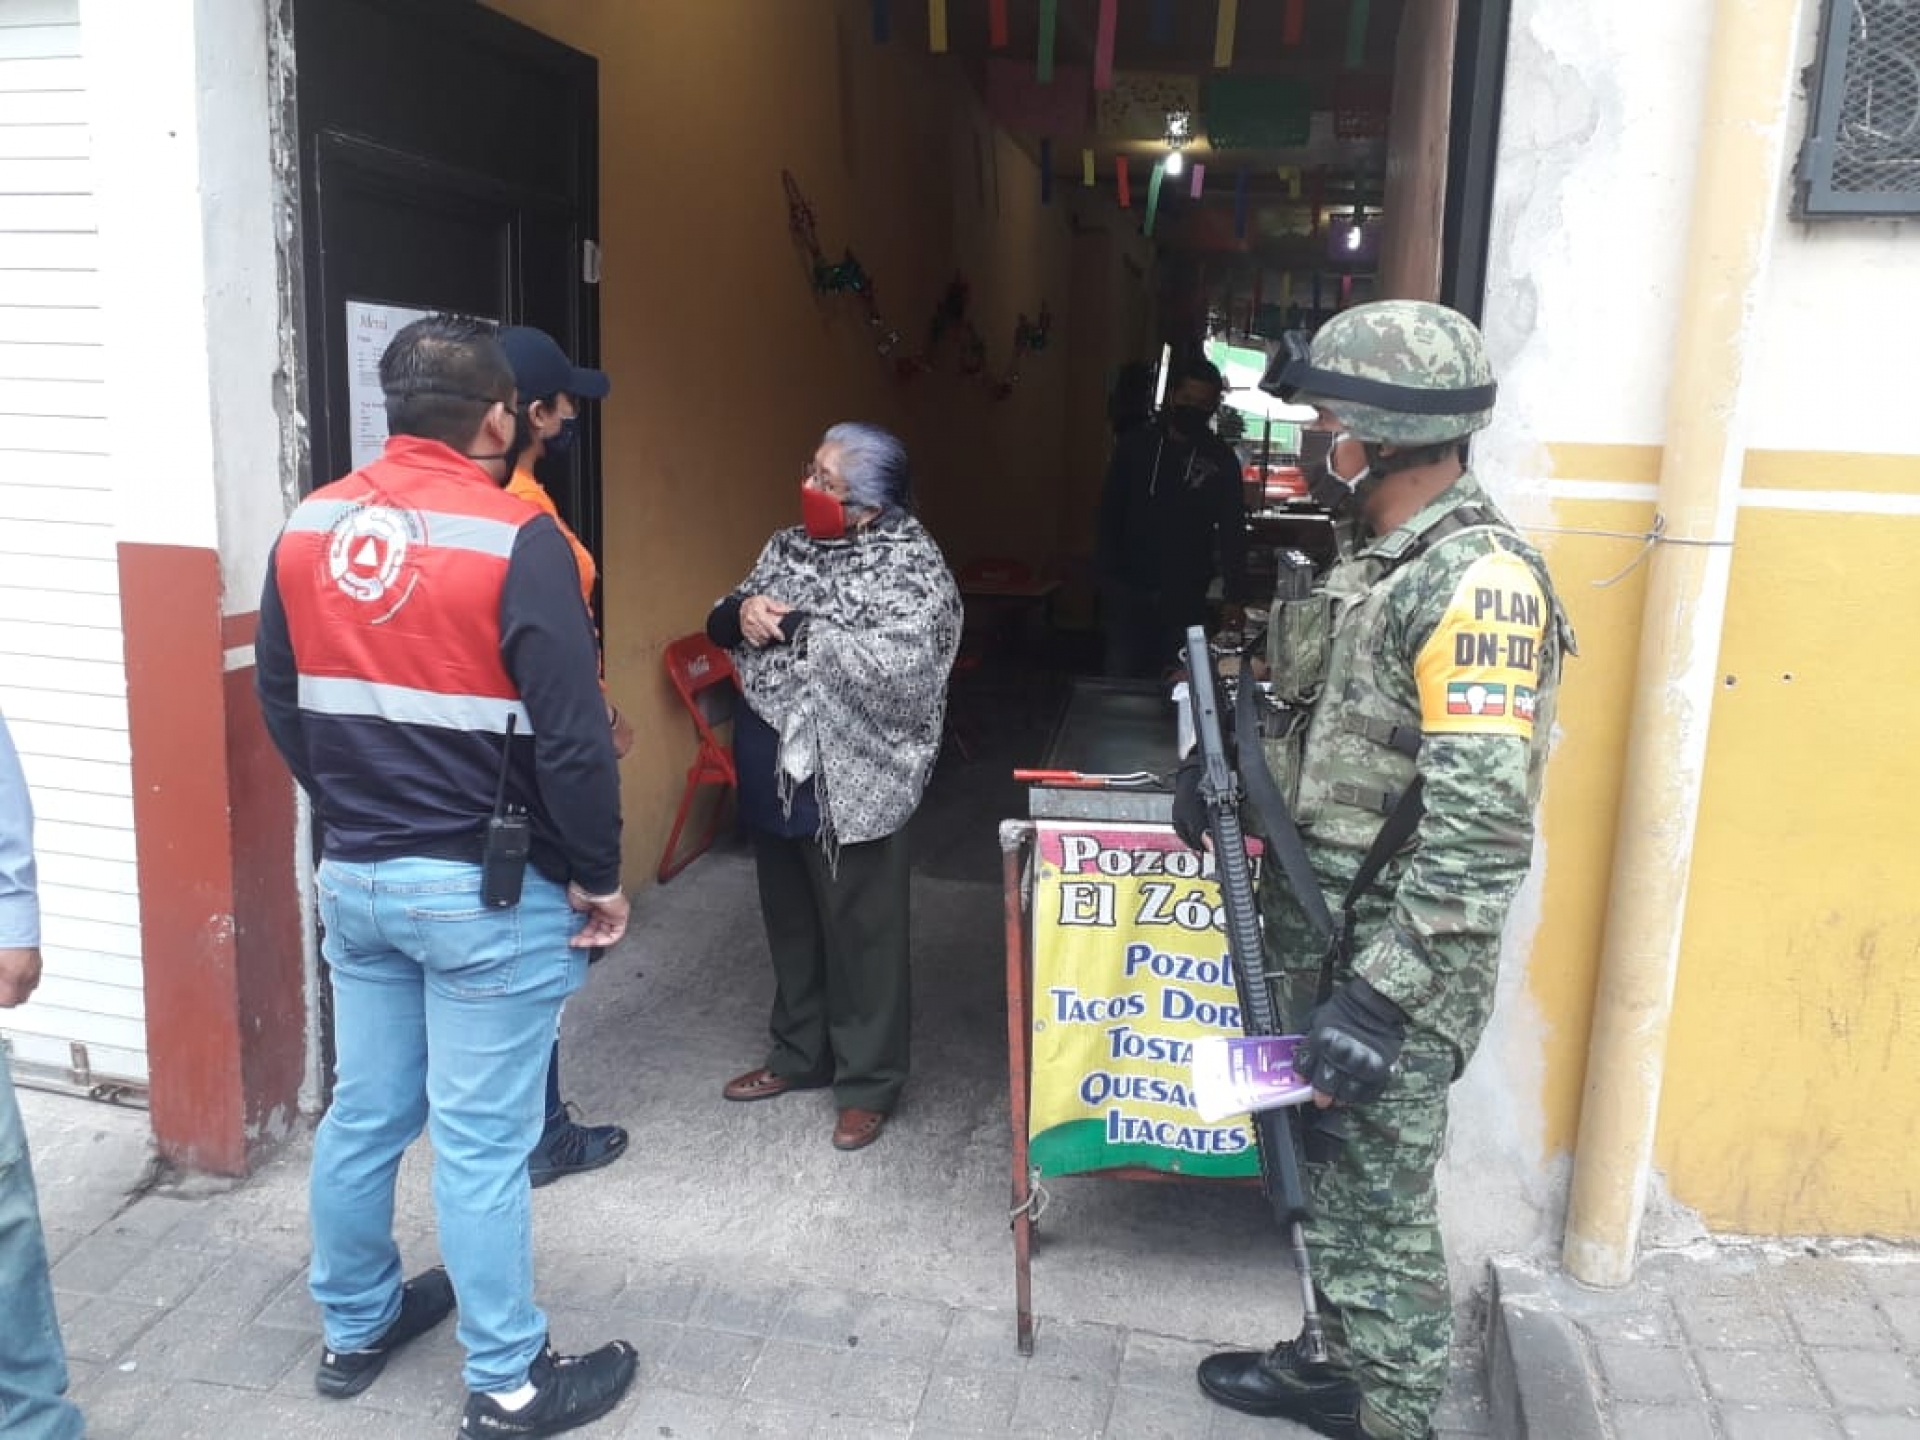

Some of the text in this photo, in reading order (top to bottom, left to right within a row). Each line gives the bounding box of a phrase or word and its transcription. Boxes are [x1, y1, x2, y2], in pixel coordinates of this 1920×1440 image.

[1475, 588, 1540, 627] PLAN
[1455, 632, 1538, 671] DN-III-
[1059, 834, 1261, 879] Pozol
[1058, 882, 1264, 932] El Zó
[1125, 944, 1233, 986] POZOL
[1162, 988, 1241, 1027] DOR
[1108, 1026, 1193, 1063] TOSTA
[1109, 1109, 1247, 1151] ITACATES
